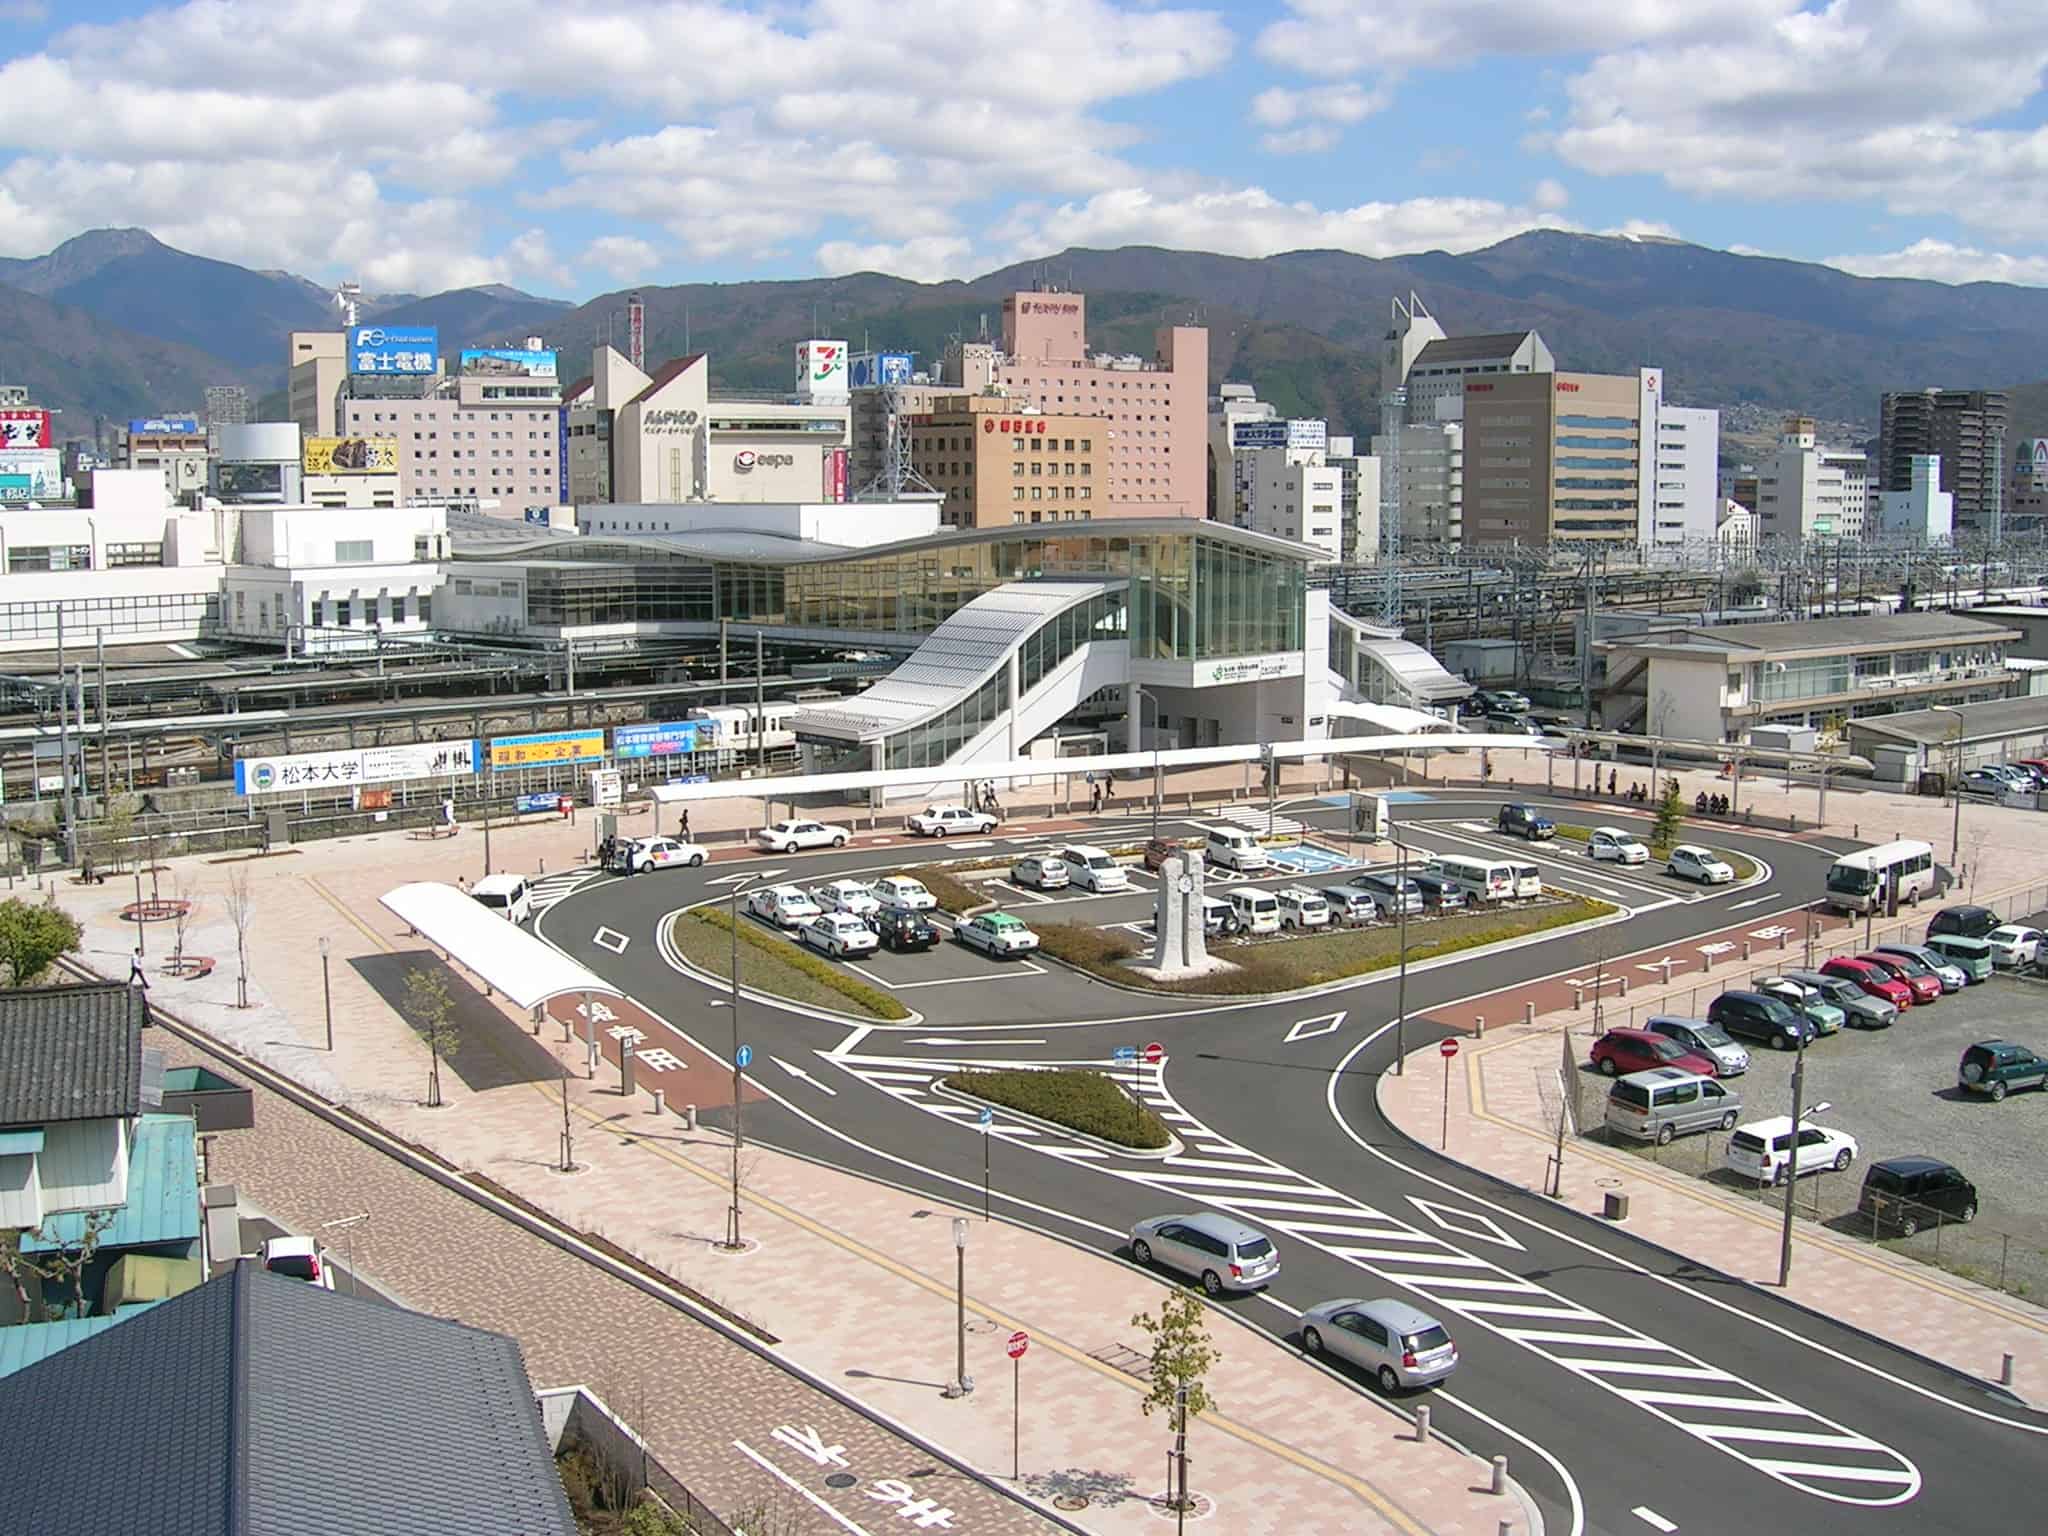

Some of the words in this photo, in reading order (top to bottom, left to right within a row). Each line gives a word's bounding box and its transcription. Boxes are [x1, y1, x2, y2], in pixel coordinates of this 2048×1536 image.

[357, 352, 433, 371] 富士電機
[281, 761, 360, 785] 松本大学
